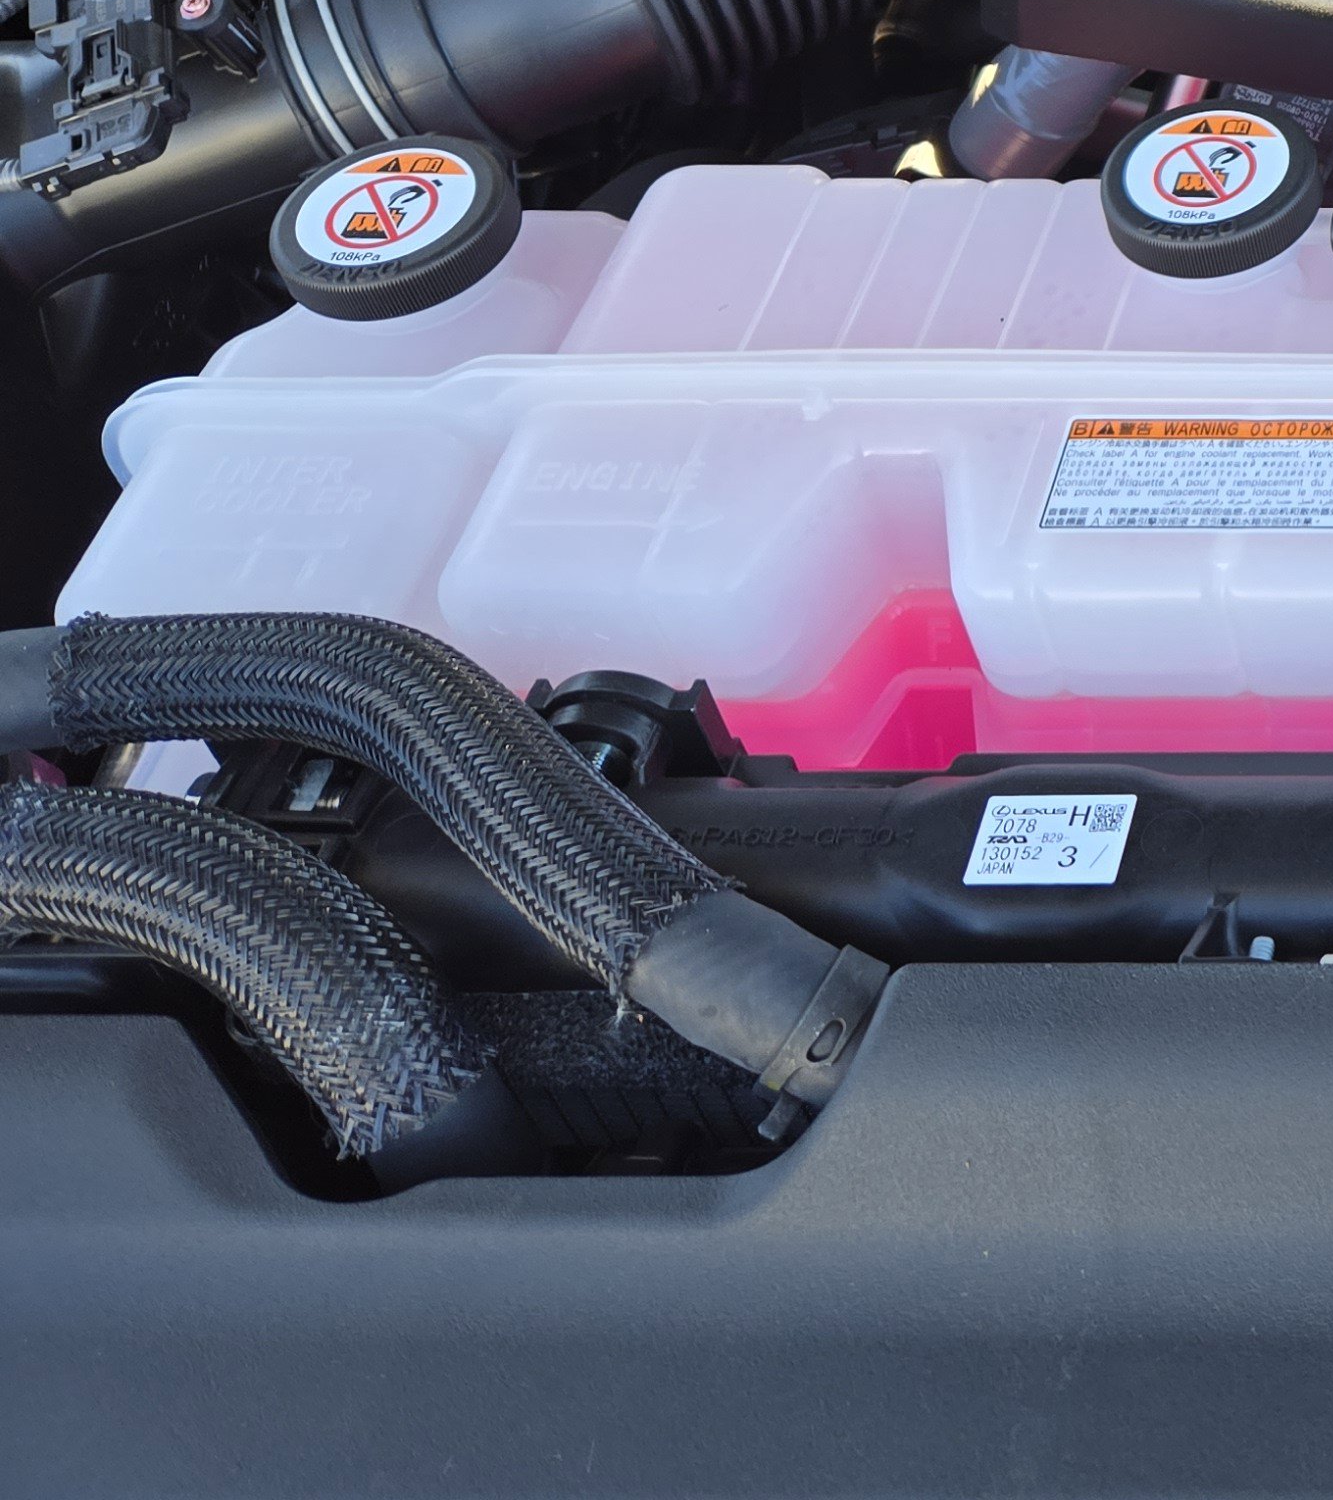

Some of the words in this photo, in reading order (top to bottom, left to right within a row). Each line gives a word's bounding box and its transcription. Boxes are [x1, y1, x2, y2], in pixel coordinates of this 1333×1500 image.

[1167, 210, 1215, 220] 108kPa
[1139, 220, 1235, 240] DENSO
[331, 252, 381, 261] 108kPa
[300, 261, 401, 283] DENSO
[1074, 422, 1088, 435] B
[1118, 422, 1152, 435] 警告
[1164, 422, 1239, 436] WARNING
[1066, 449, 1096, 460] Check
[1101, 449, 1125, 458] label
[1129, 449, 1139, 457] A
[1143, 449, 1158, 457] for
[1162, 450, 1196, 458] engine
[1200, 450, 1237, 458] coolant
[1241, 450, 1302, 460] replacement.
[1307, 450, 1333, 458] Work
[526, 462, 705, 491] ENGINE
[1056, 477, 1107, 489] Consulter
[1109, 478, 1165, 489] l'étiquette
[1169, 478, 1180, 489] A
[1185, 479, 1210, 487] pour
[1216, 478, 1226, 489] le
[1231, 478, 1303, 489] remplacement
[1309, 478, 1324, 487] du
[1053, 488, 1068, 498] Ne
[1073, 488, 1121, 497] procéder
[1146, 488, 1220, 498] remplacement
[1224, 488, 1246, 498] que
[1249, 488, 1291, 499] lorsque
[1296, 488, 1306, 499] le
[1068, 805, 1092, 826] H
[994, 819, 1038, 834] 7078
[981, 846, 1043, 860] 130152
[1057, 845, 1078, 868] 3
[977, 862, 1015, 875] JAPAN
